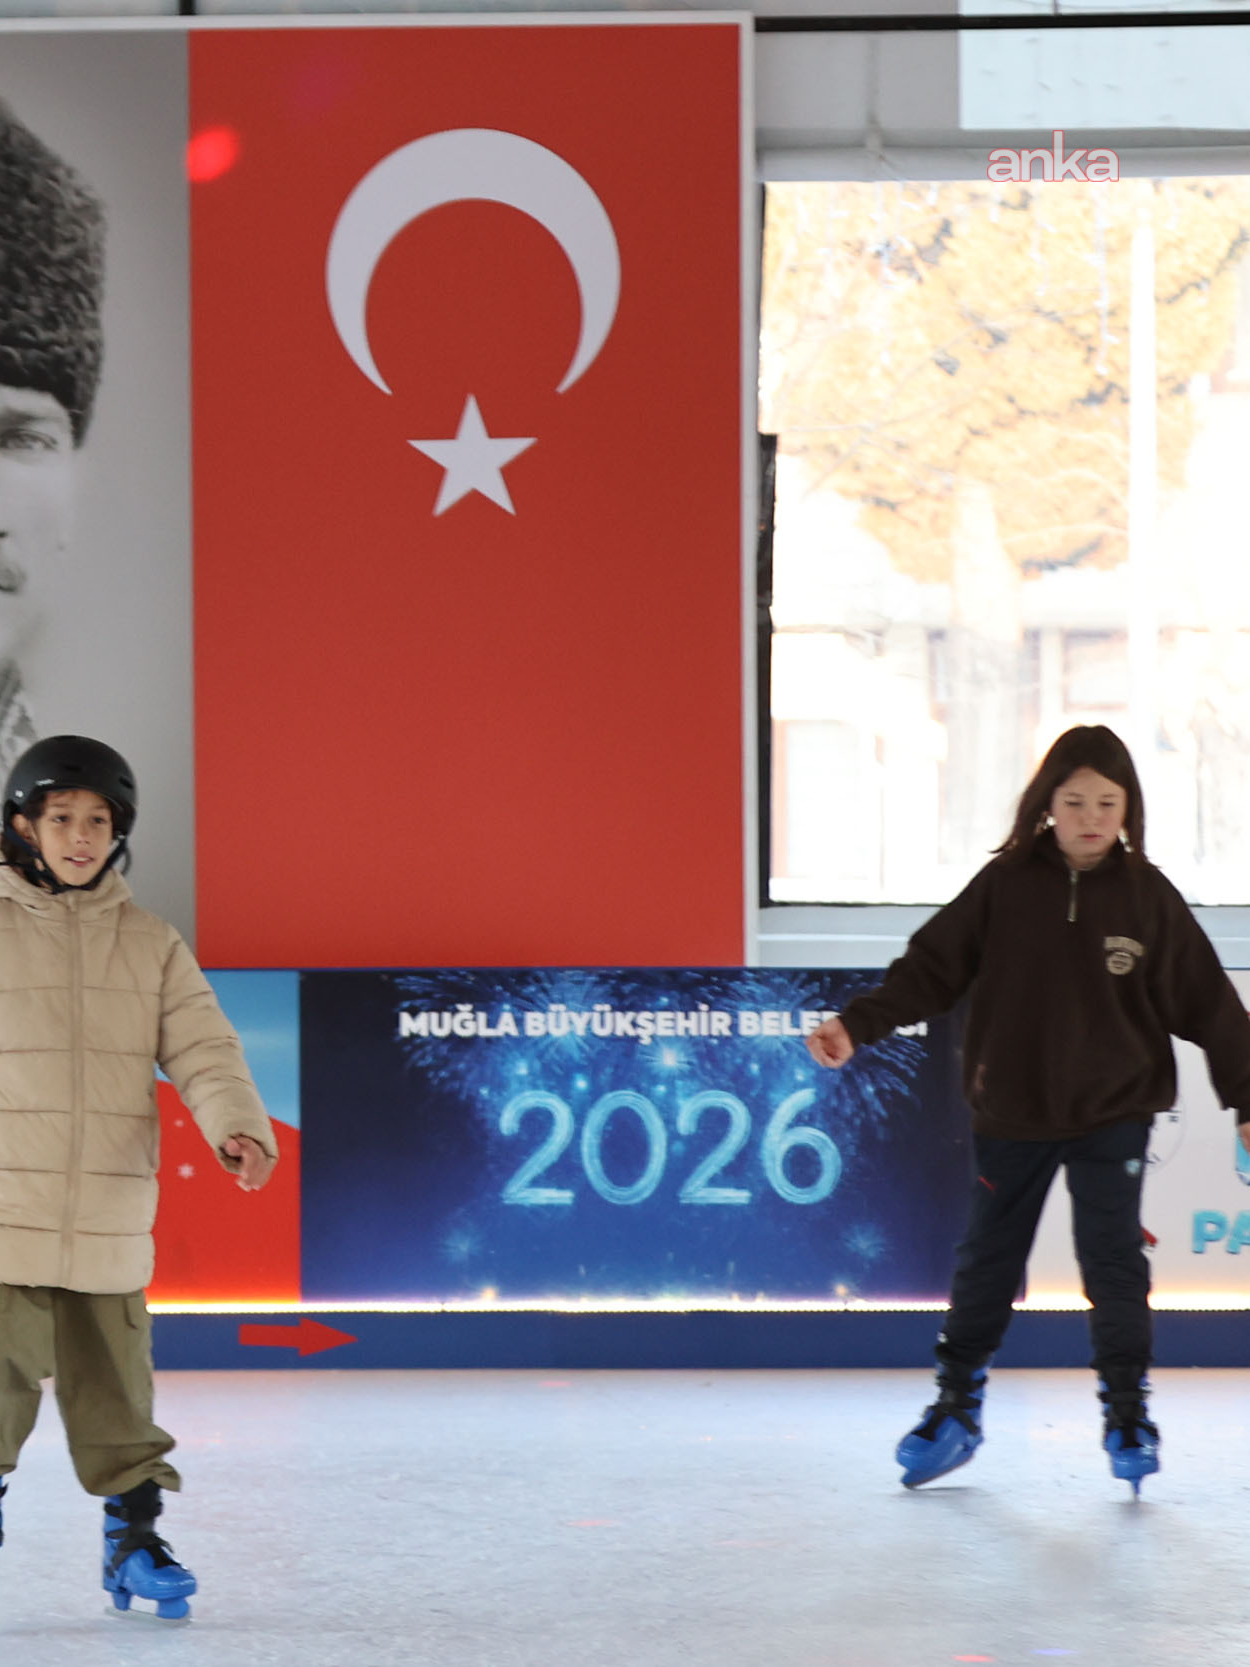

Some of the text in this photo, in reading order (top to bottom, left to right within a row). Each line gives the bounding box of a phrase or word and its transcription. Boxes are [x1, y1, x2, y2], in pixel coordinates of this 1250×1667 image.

[399, 1004, 519, 1037] MUĞLA
[524, 1004, 732, 1045] BÜYÜKŞEHİR
[500, 1088, 841, 1205] 2026
